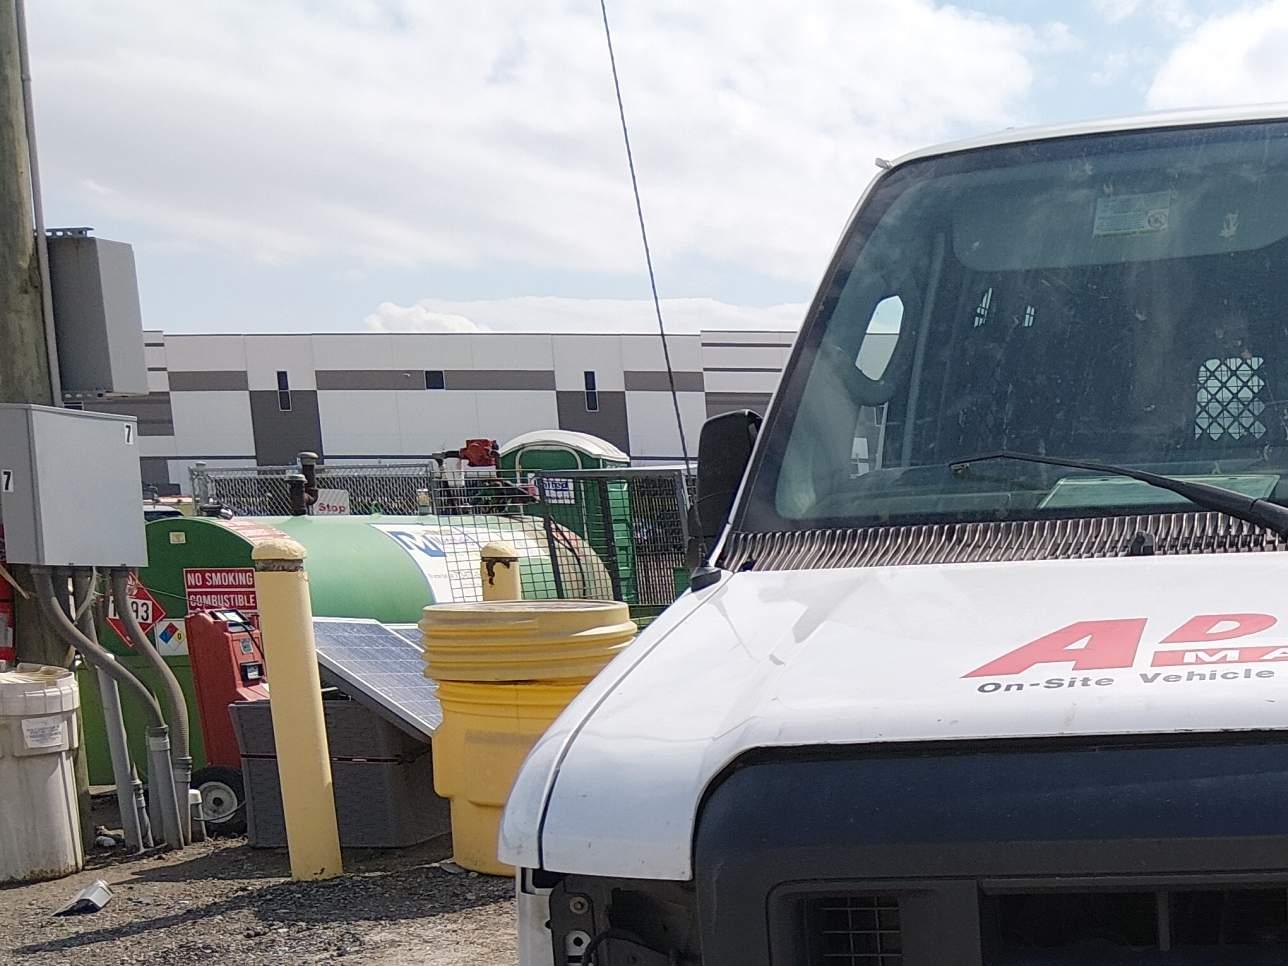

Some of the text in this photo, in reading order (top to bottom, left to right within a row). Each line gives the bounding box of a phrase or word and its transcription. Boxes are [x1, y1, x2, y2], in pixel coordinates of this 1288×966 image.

[125, 424, 132, 443] 7
[3, 470, 12, 491] 7
[318, 502, 346, 513] Stop
[187, 571, 254, 586] NO SMOKING
[190, 593, 256, 607] COMBUSTIBLE
[977, 674, 1114, 694] On-Site
[1140, 666, 1275, 684] Vehicle
